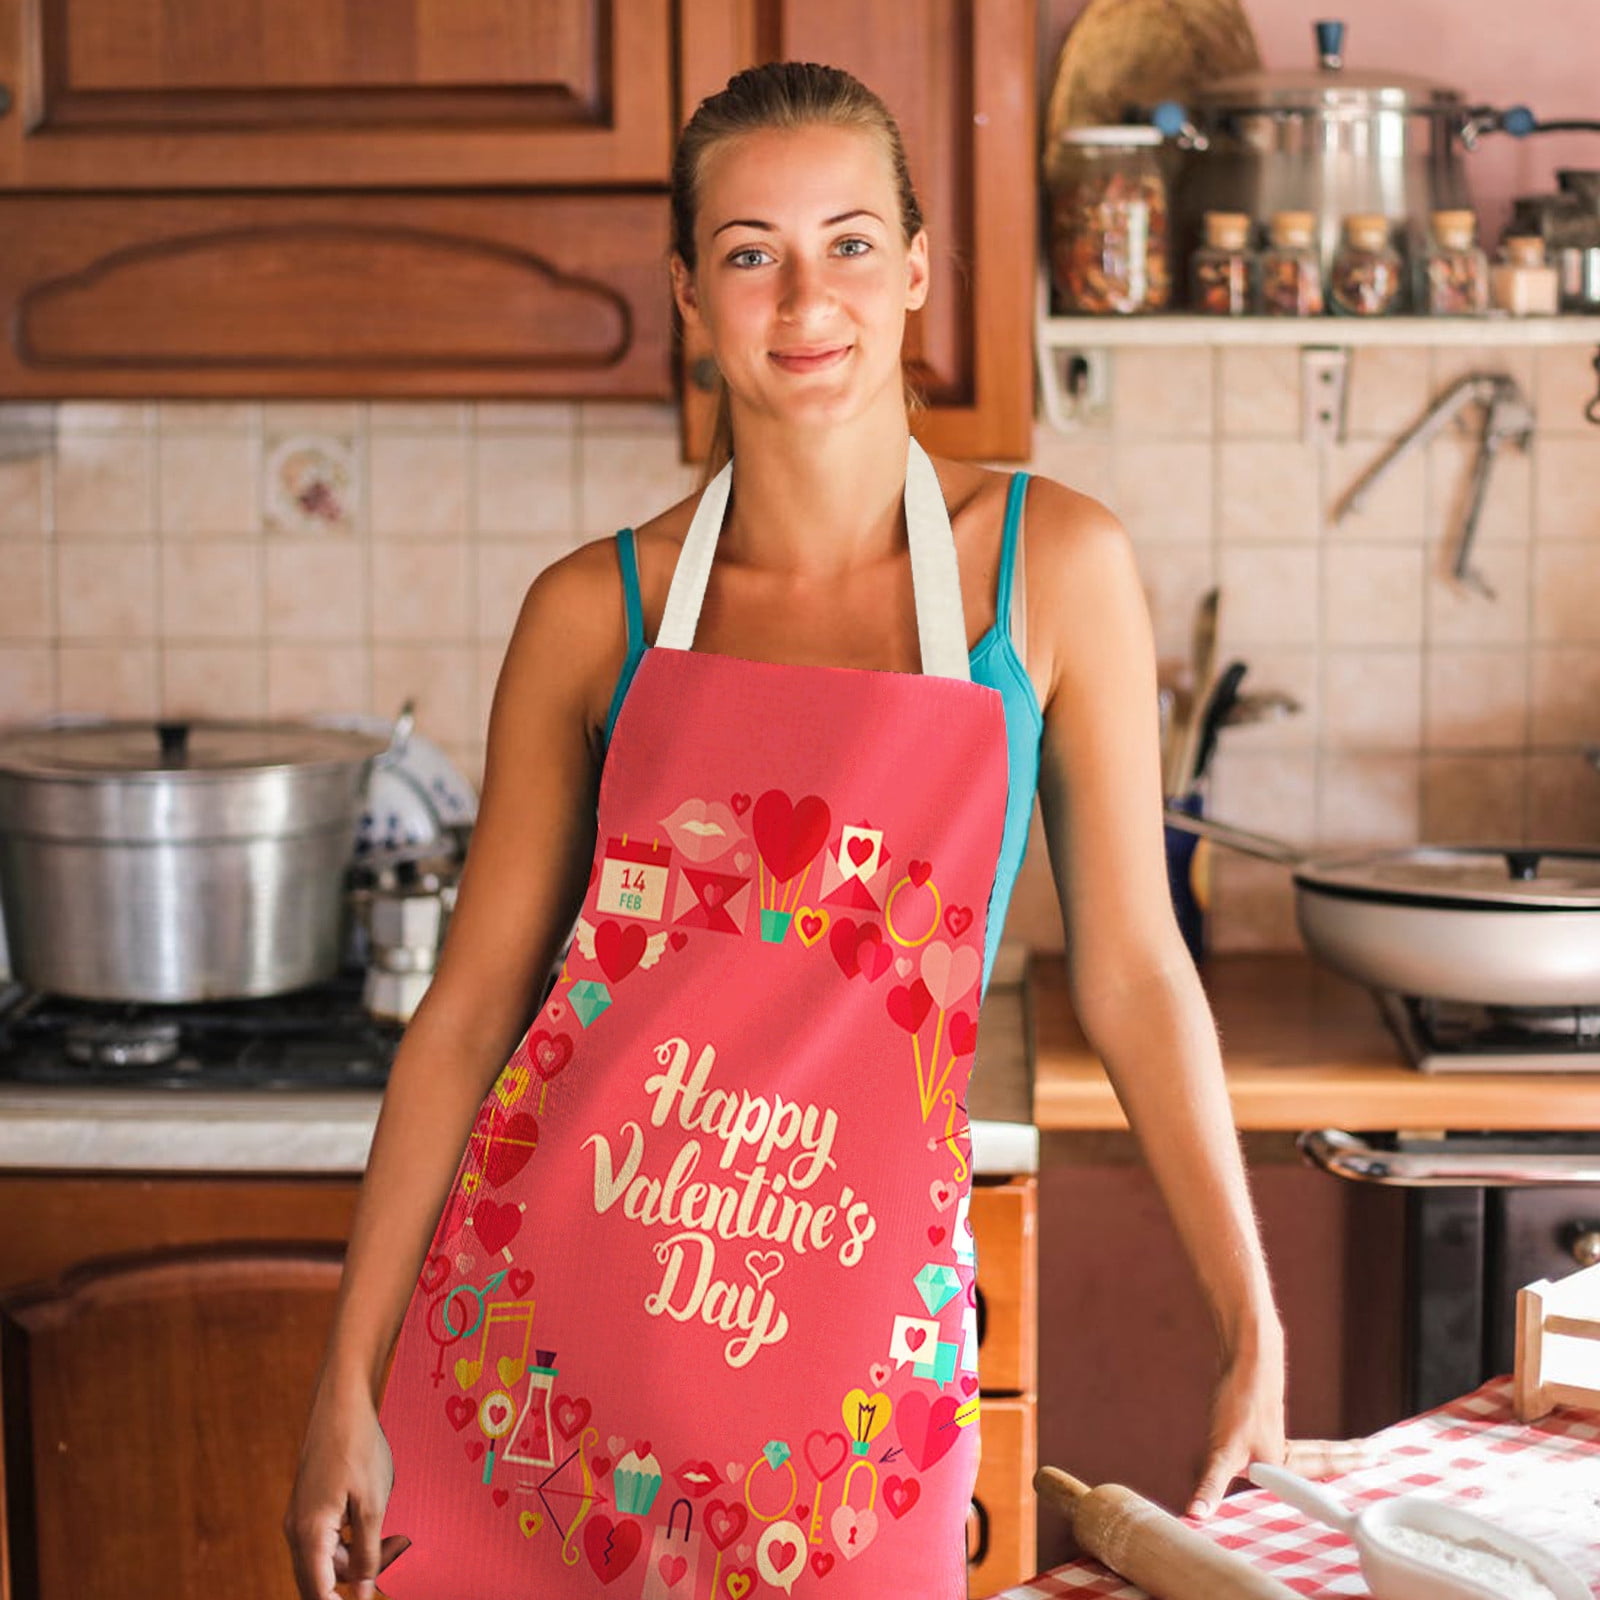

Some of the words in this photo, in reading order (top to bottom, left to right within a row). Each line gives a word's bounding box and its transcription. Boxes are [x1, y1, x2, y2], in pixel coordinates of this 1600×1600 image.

[619, 893, 642, 910] FEB
[621, 868, 645, 892] 14
[644, 1037, 838, 1190] Happy
[580, 1121, 876, 1267] Valentine's
[644, 1232, 789, 1368] Day
